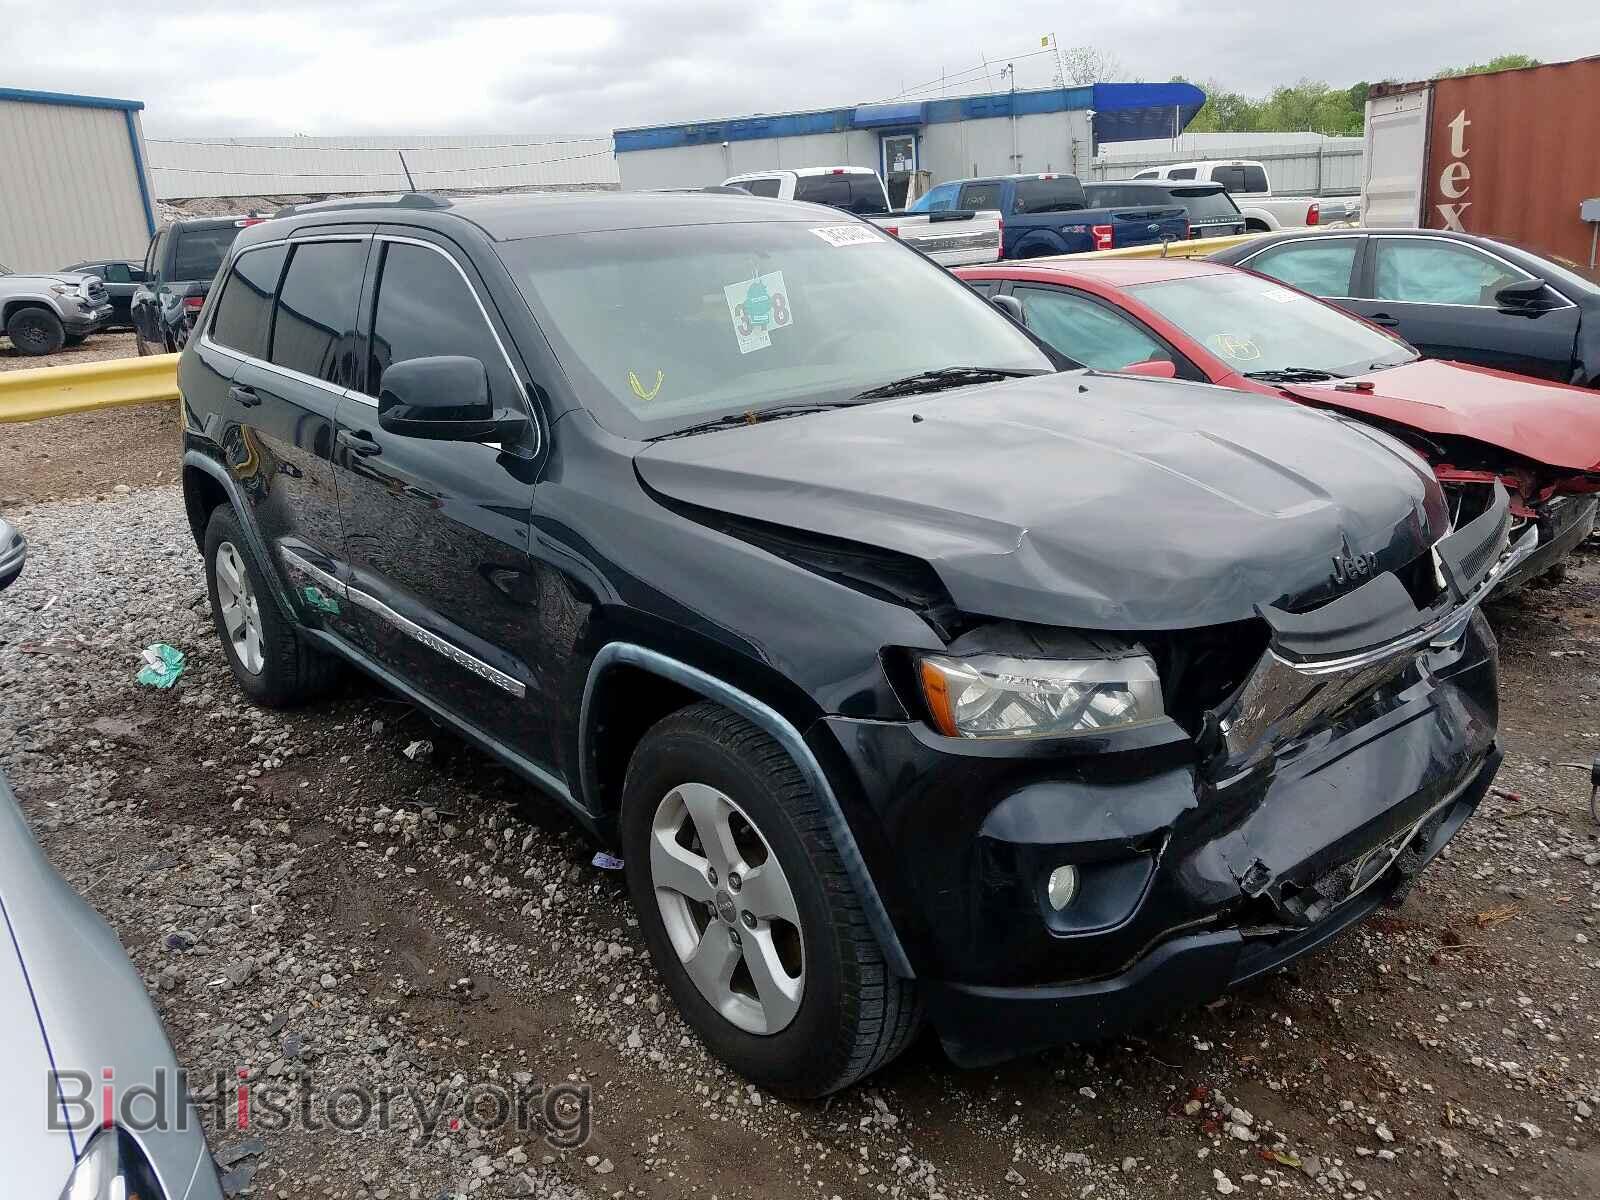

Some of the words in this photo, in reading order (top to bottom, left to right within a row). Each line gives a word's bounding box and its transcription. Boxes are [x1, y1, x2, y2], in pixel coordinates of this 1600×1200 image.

[1436, 109, 1473, 232] tex
[1332, 552, 1376, 585] Jeep
[416, 630, 450, 657] GRAND
[452, 651, 512, 692] CHEROKEE
